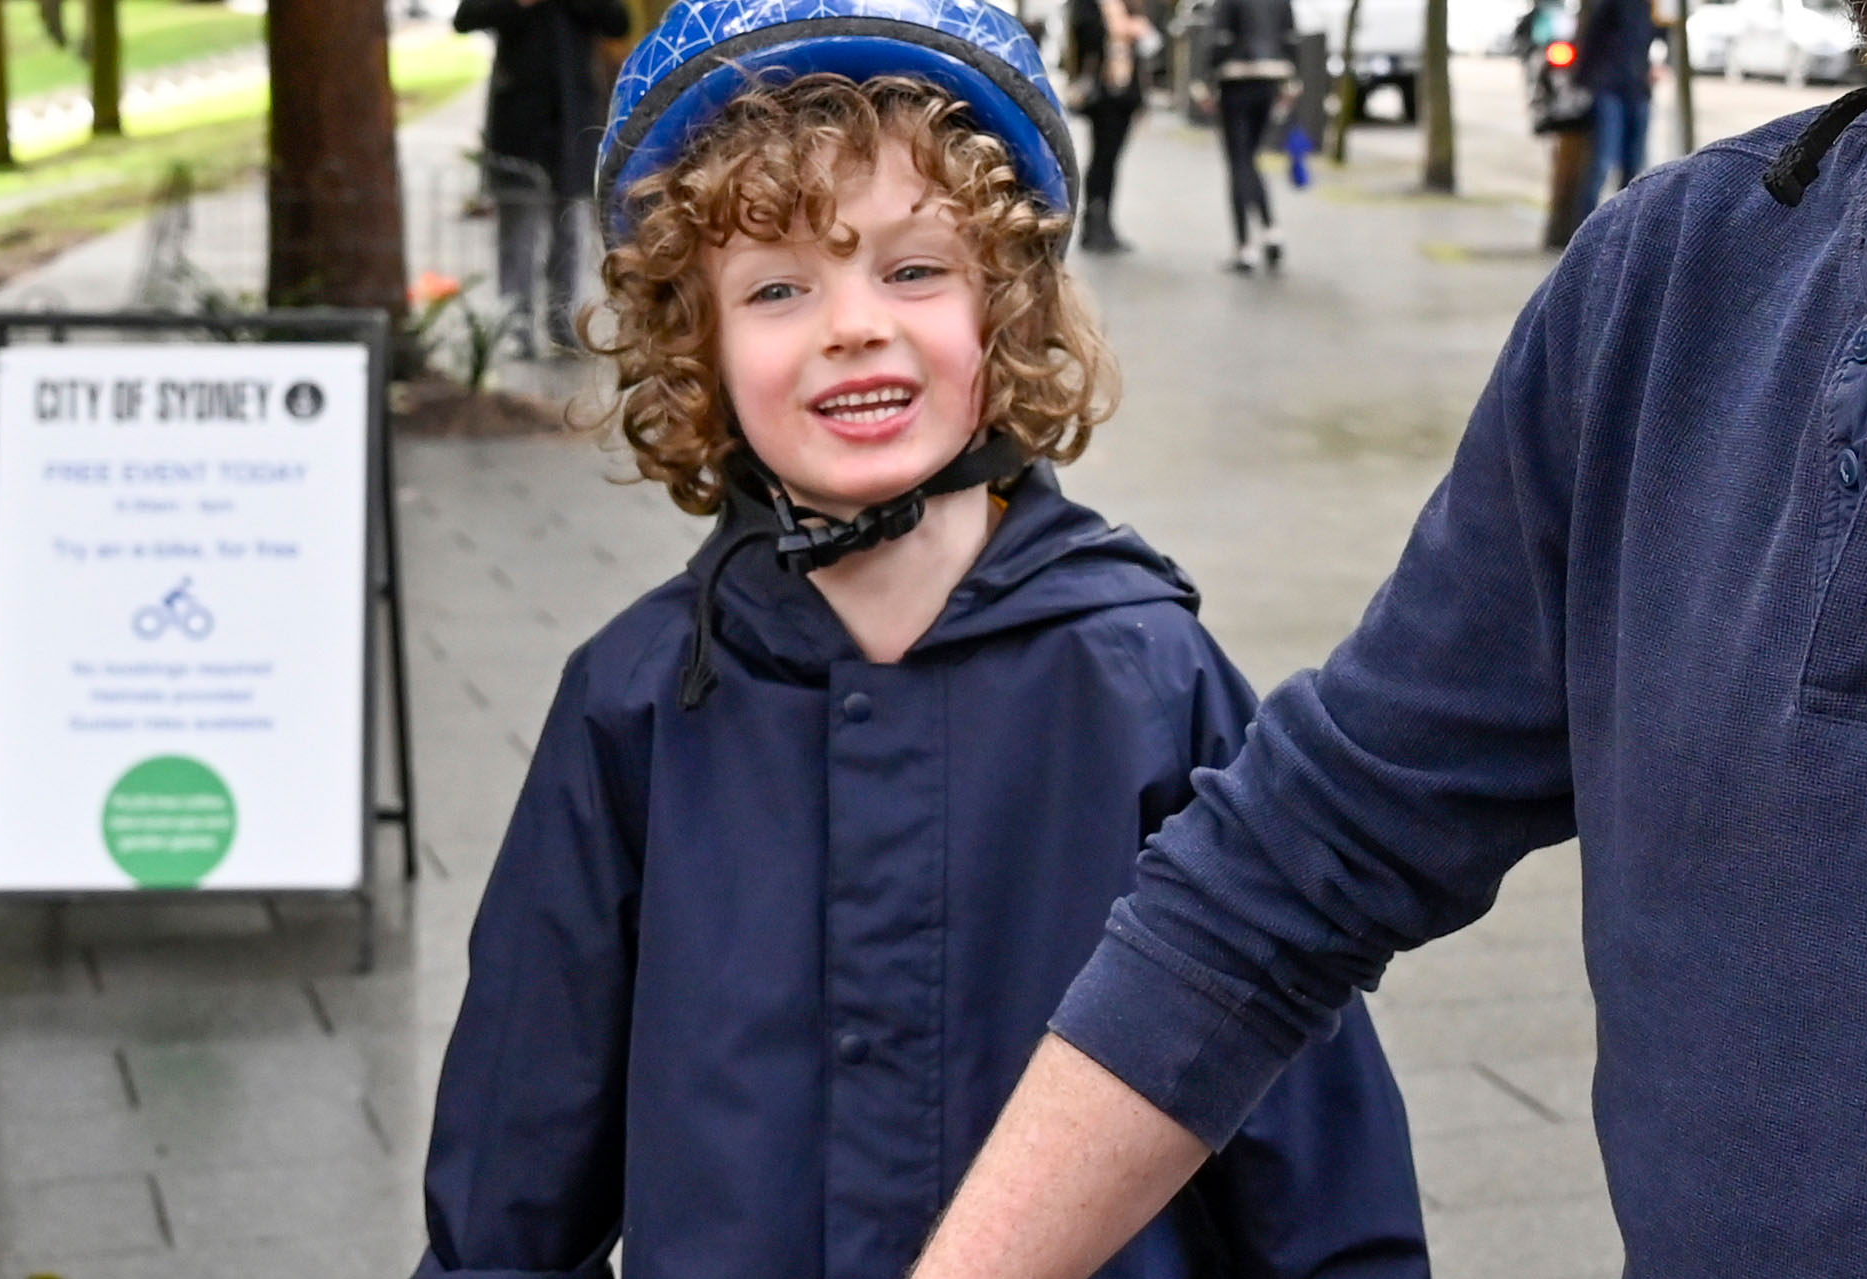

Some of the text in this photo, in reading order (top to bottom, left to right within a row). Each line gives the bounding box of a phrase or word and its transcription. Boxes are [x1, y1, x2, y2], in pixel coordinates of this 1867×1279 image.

[36, 381, 272, 422] CITY OF SYDNEY
